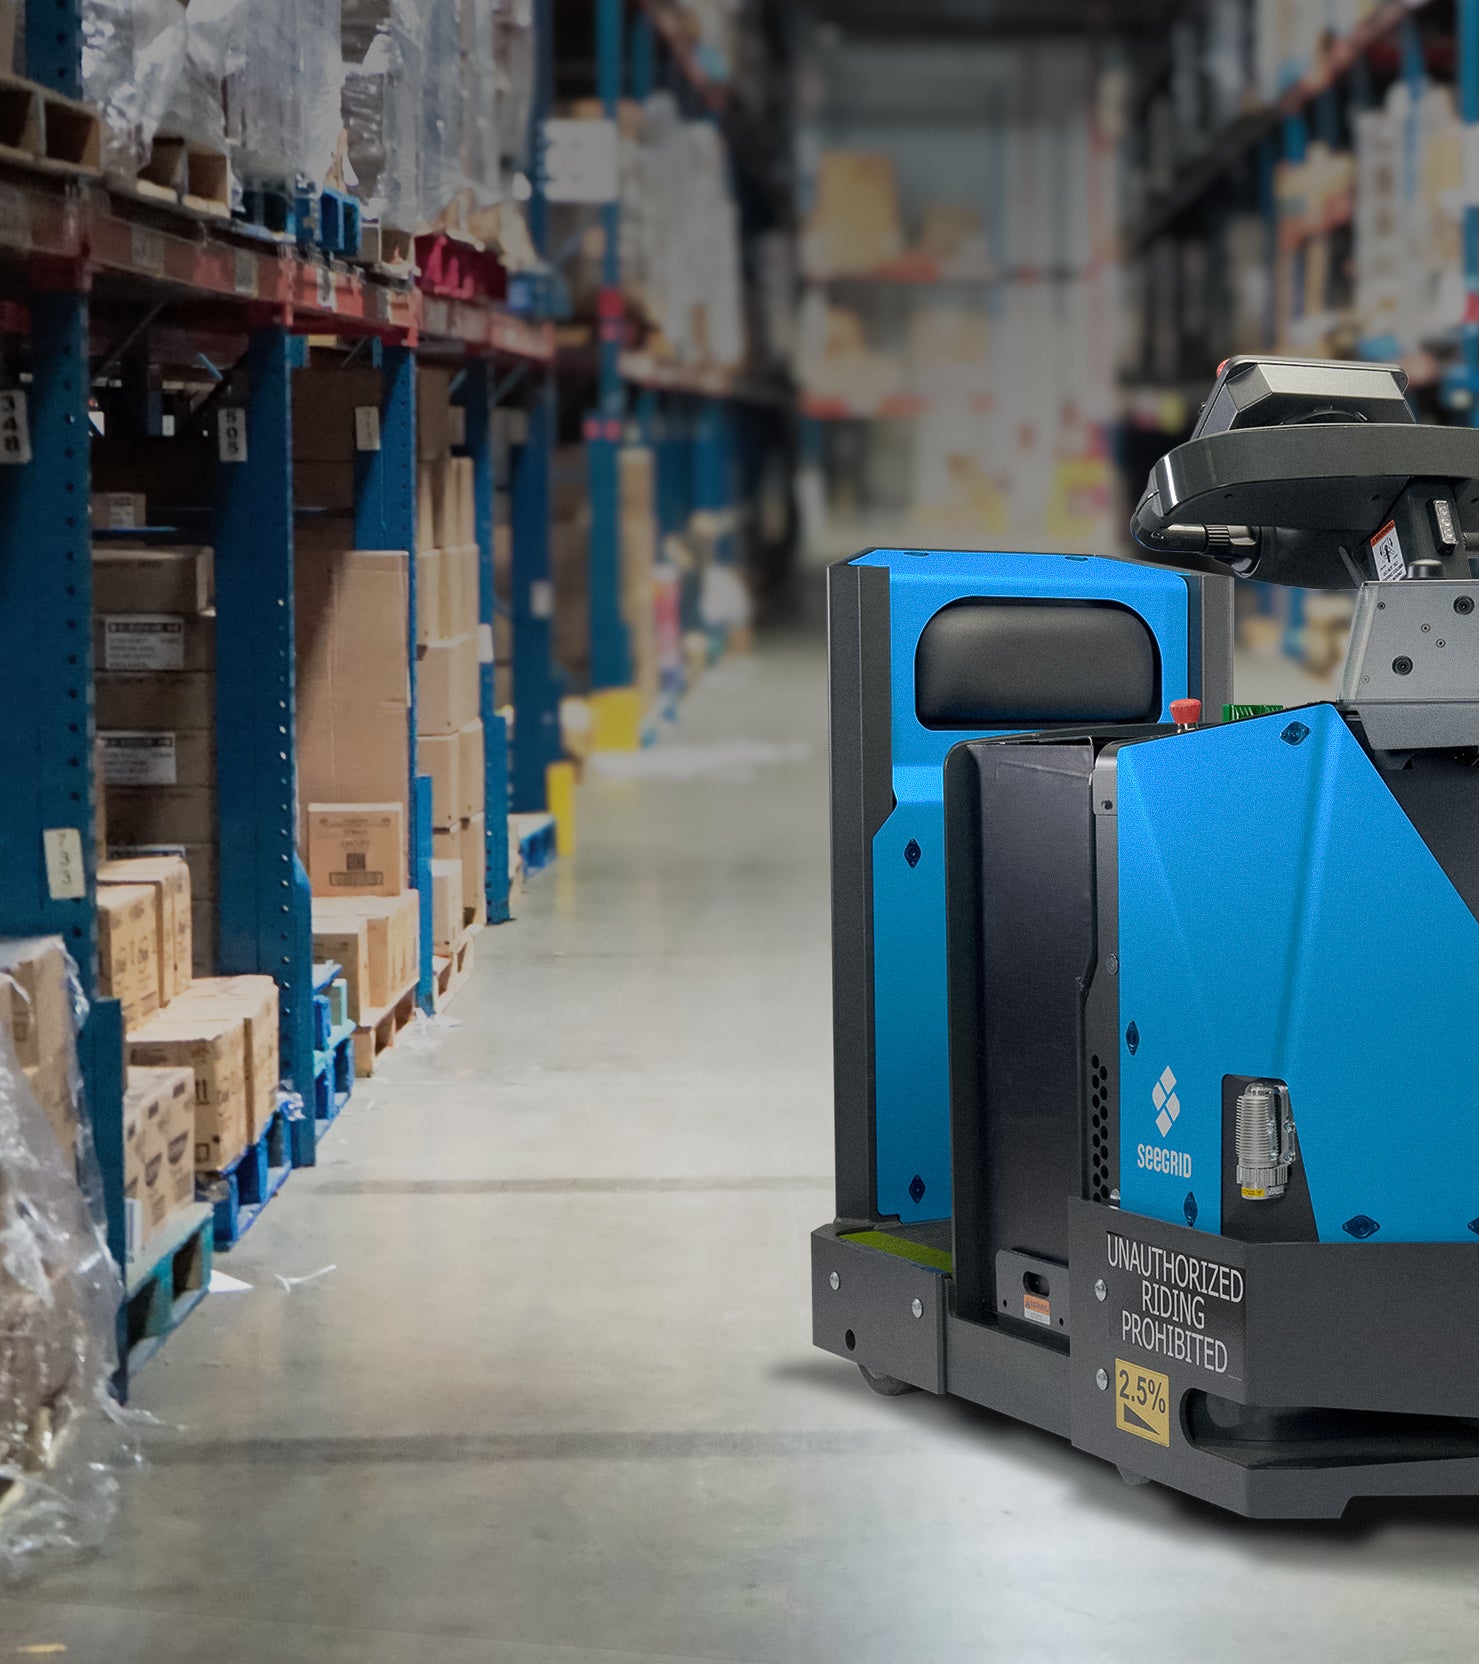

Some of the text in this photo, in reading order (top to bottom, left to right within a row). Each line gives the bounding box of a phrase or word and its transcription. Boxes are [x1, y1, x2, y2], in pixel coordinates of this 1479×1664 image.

[1107, 1234, 1244, 1303] UNAUTHORIZED
[1142, 1280, 1205, 1329] RIDING
[1122, 1310, 1228, 1373] PROHIBITED
[1119, 1369, 1166, 1414] 2.5%
